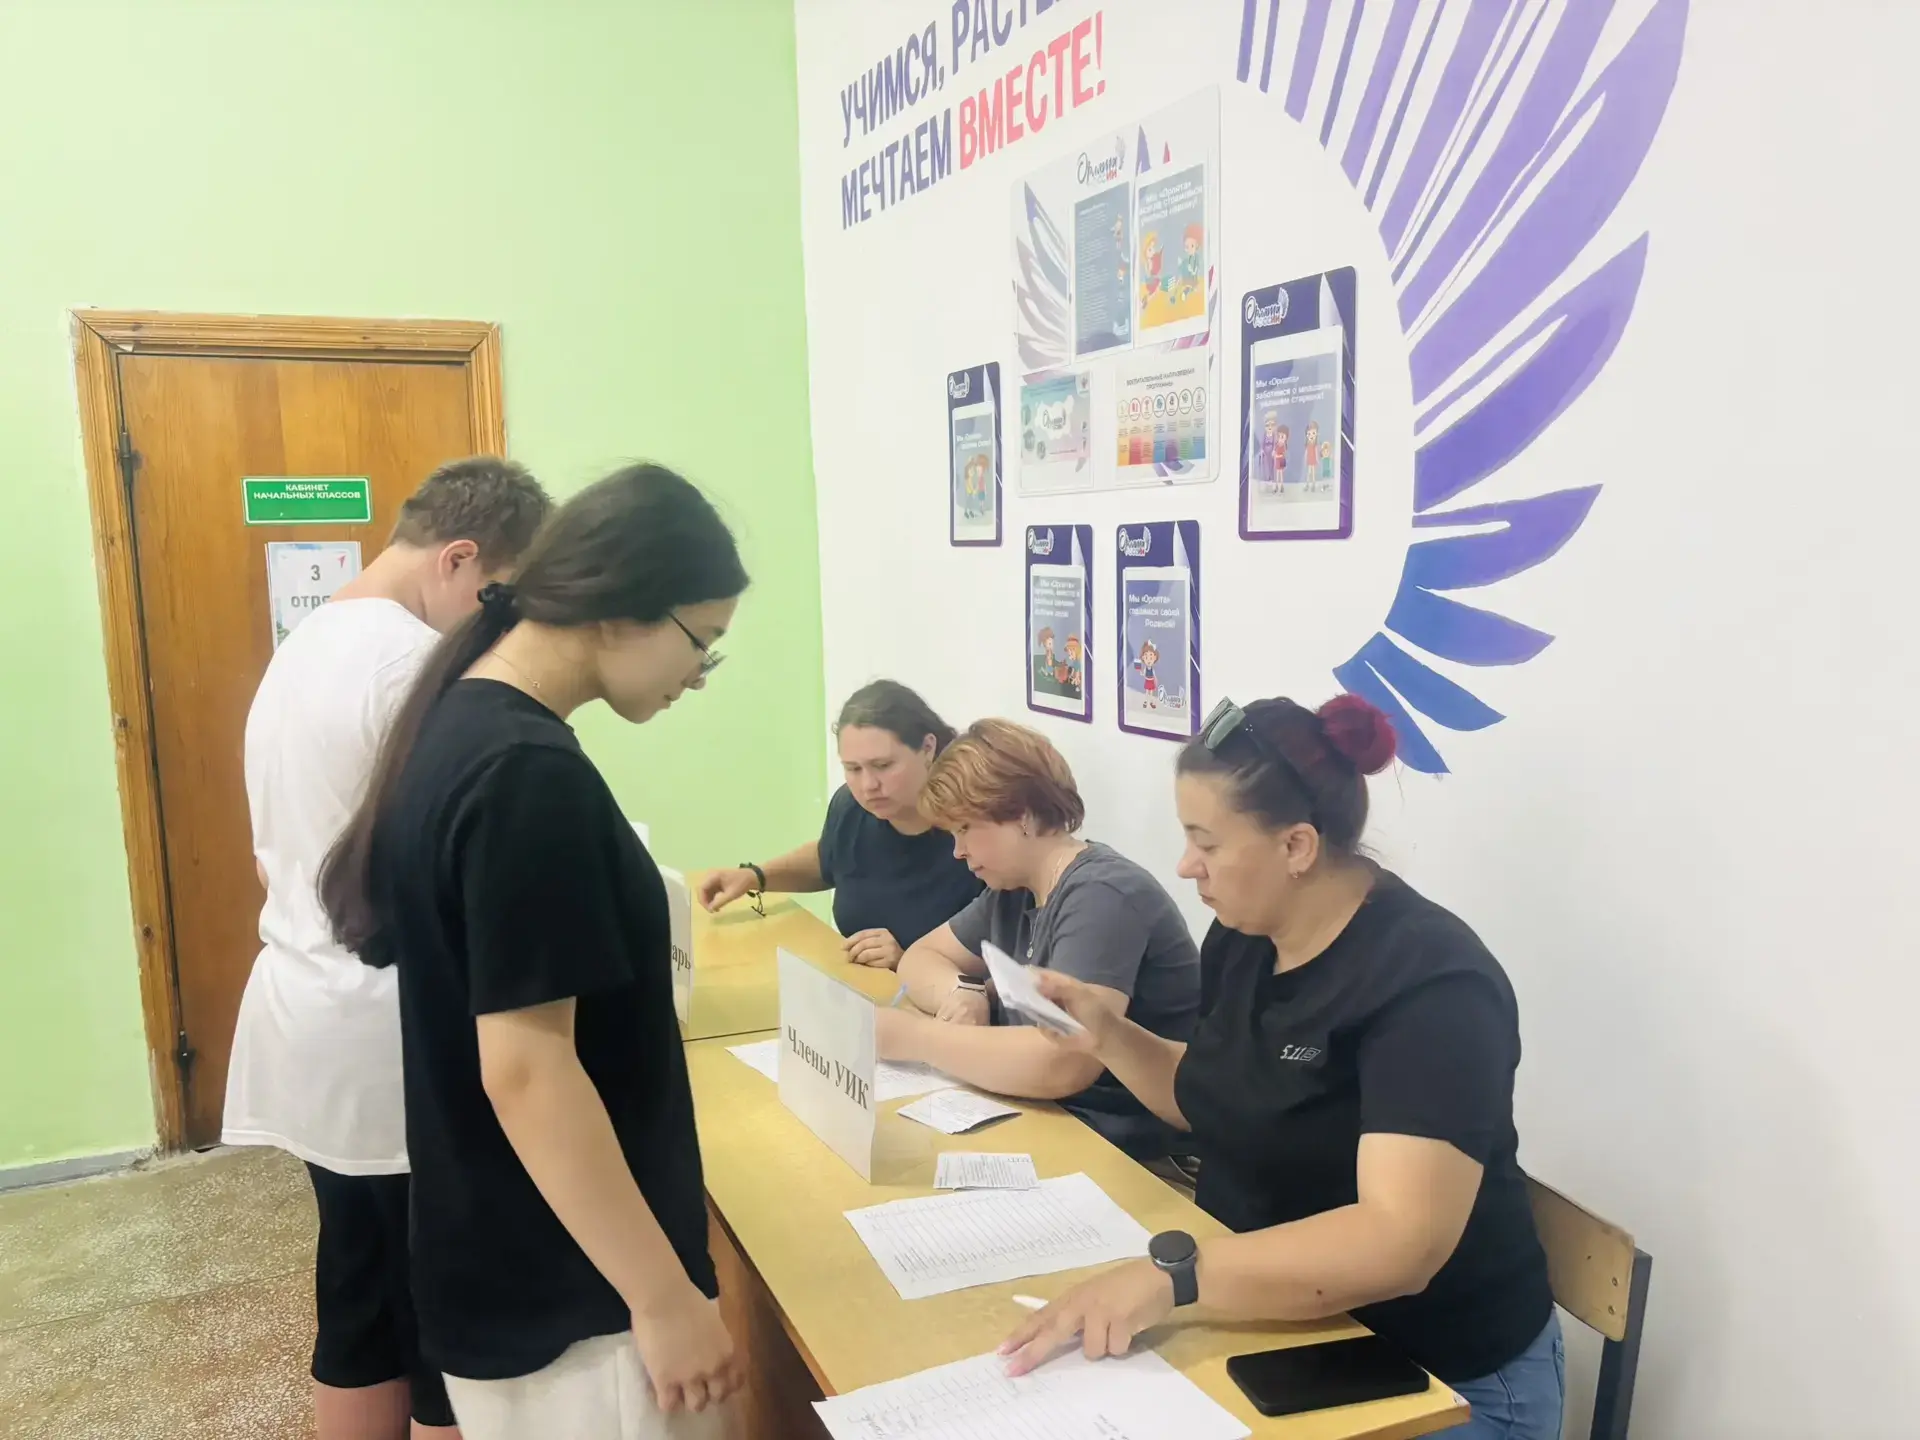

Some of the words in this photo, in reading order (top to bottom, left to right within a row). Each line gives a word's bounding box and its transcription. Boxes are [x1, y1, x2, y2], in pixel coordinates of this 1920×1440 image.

[841, 20, 944, 148] УЧИМСЯ,
[842, 108, 952, 230] МЕЧТАЕМ
[959, 10, 1106, 170] ВМЕСТЕ!
[254, 492, 315, 500] НАЧАЛЬНЫХ
[317, 491, 361, 499] КЛАССОВ
[286, 483, 330, 491] КАБИНЕТ
[311, 565, 321, 581] 3
[672, 944, 691, 971] арь
[788, 1024, 831, 1079] Члены
[835, 1059, 869, 1111] УИК
